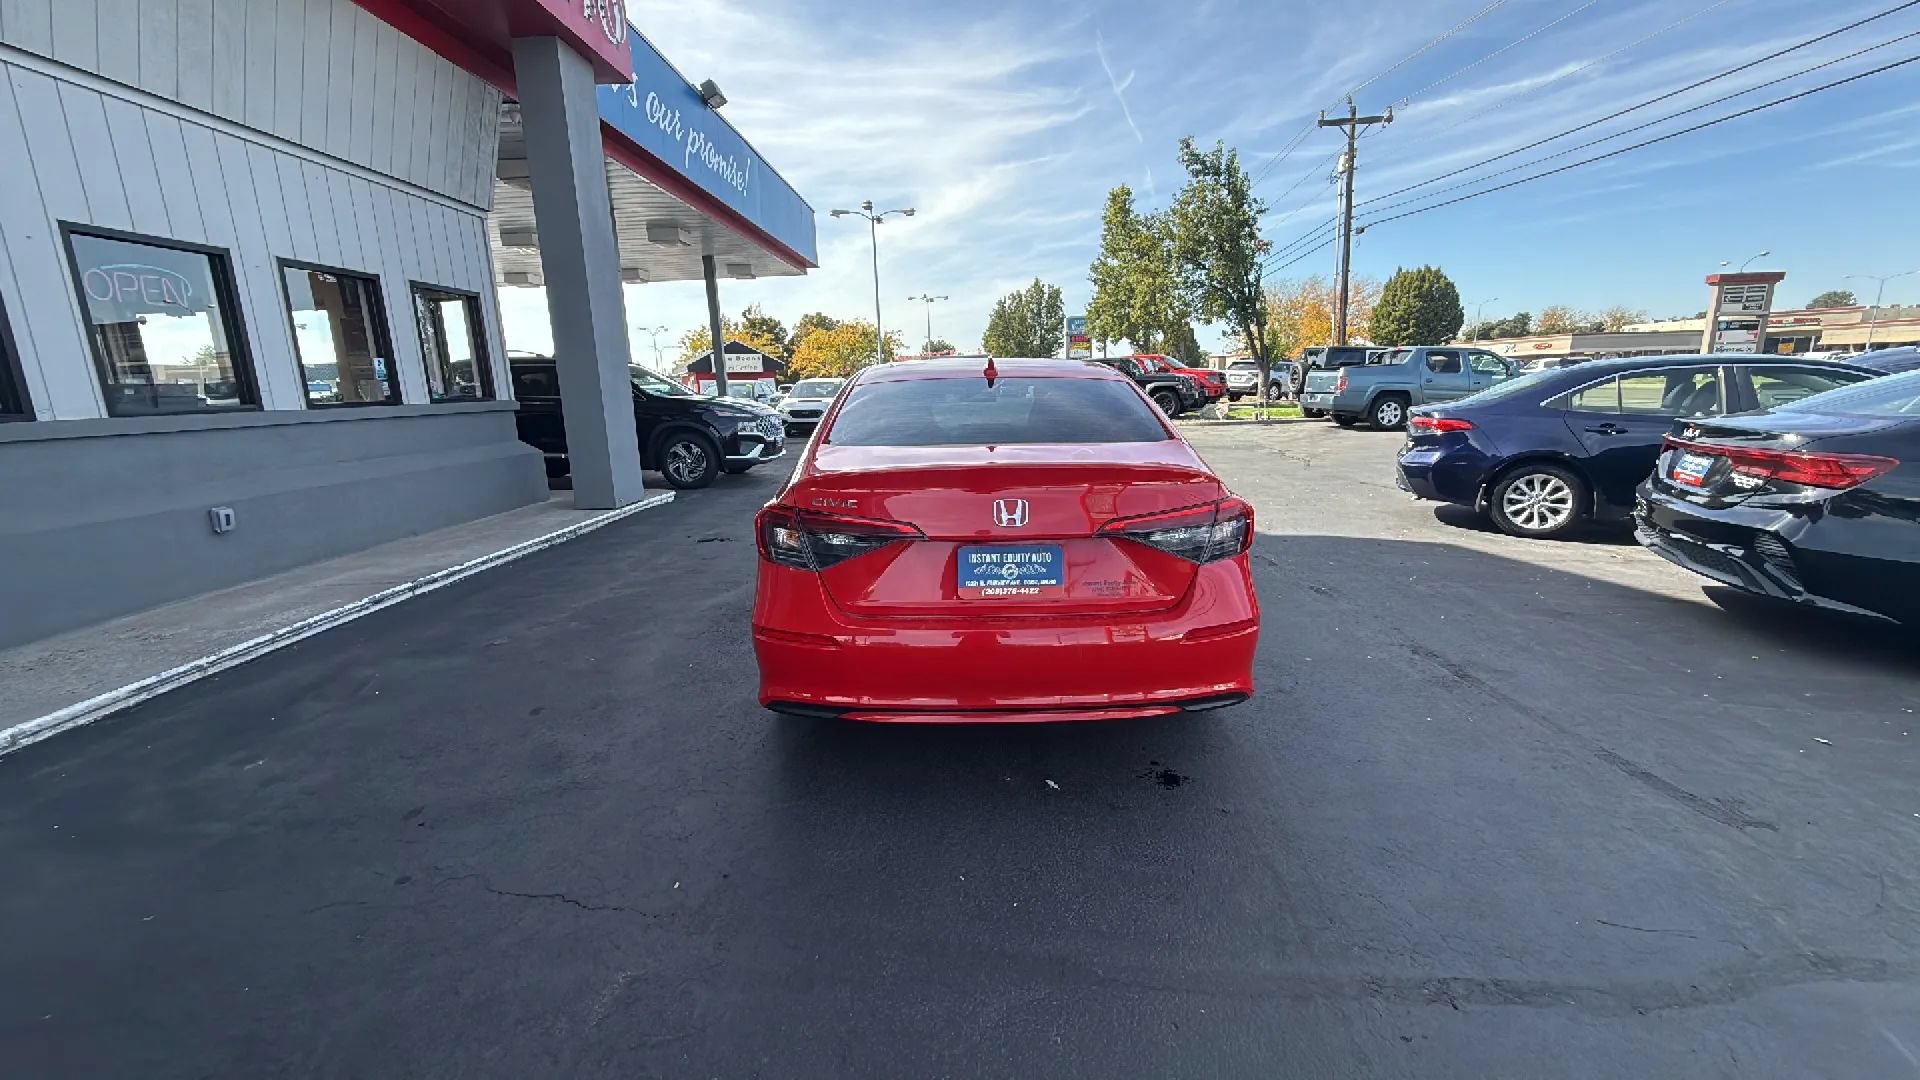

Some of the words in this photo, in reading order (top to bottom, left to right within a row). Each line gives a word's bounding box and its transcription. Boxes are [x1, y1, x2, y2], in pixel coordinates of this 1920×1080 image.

[645, 91, 685, 142] our
[685, 127, 751, 197] promise!
[84, 269, 189, 308] OPEN
[811, 497, 859, 509] CIVIC
[968, 553, 1001, 564] INSTANT
[1002, 552, 1030, 563] EQUITY
[1031, 551, 1052, 563] AUTO
